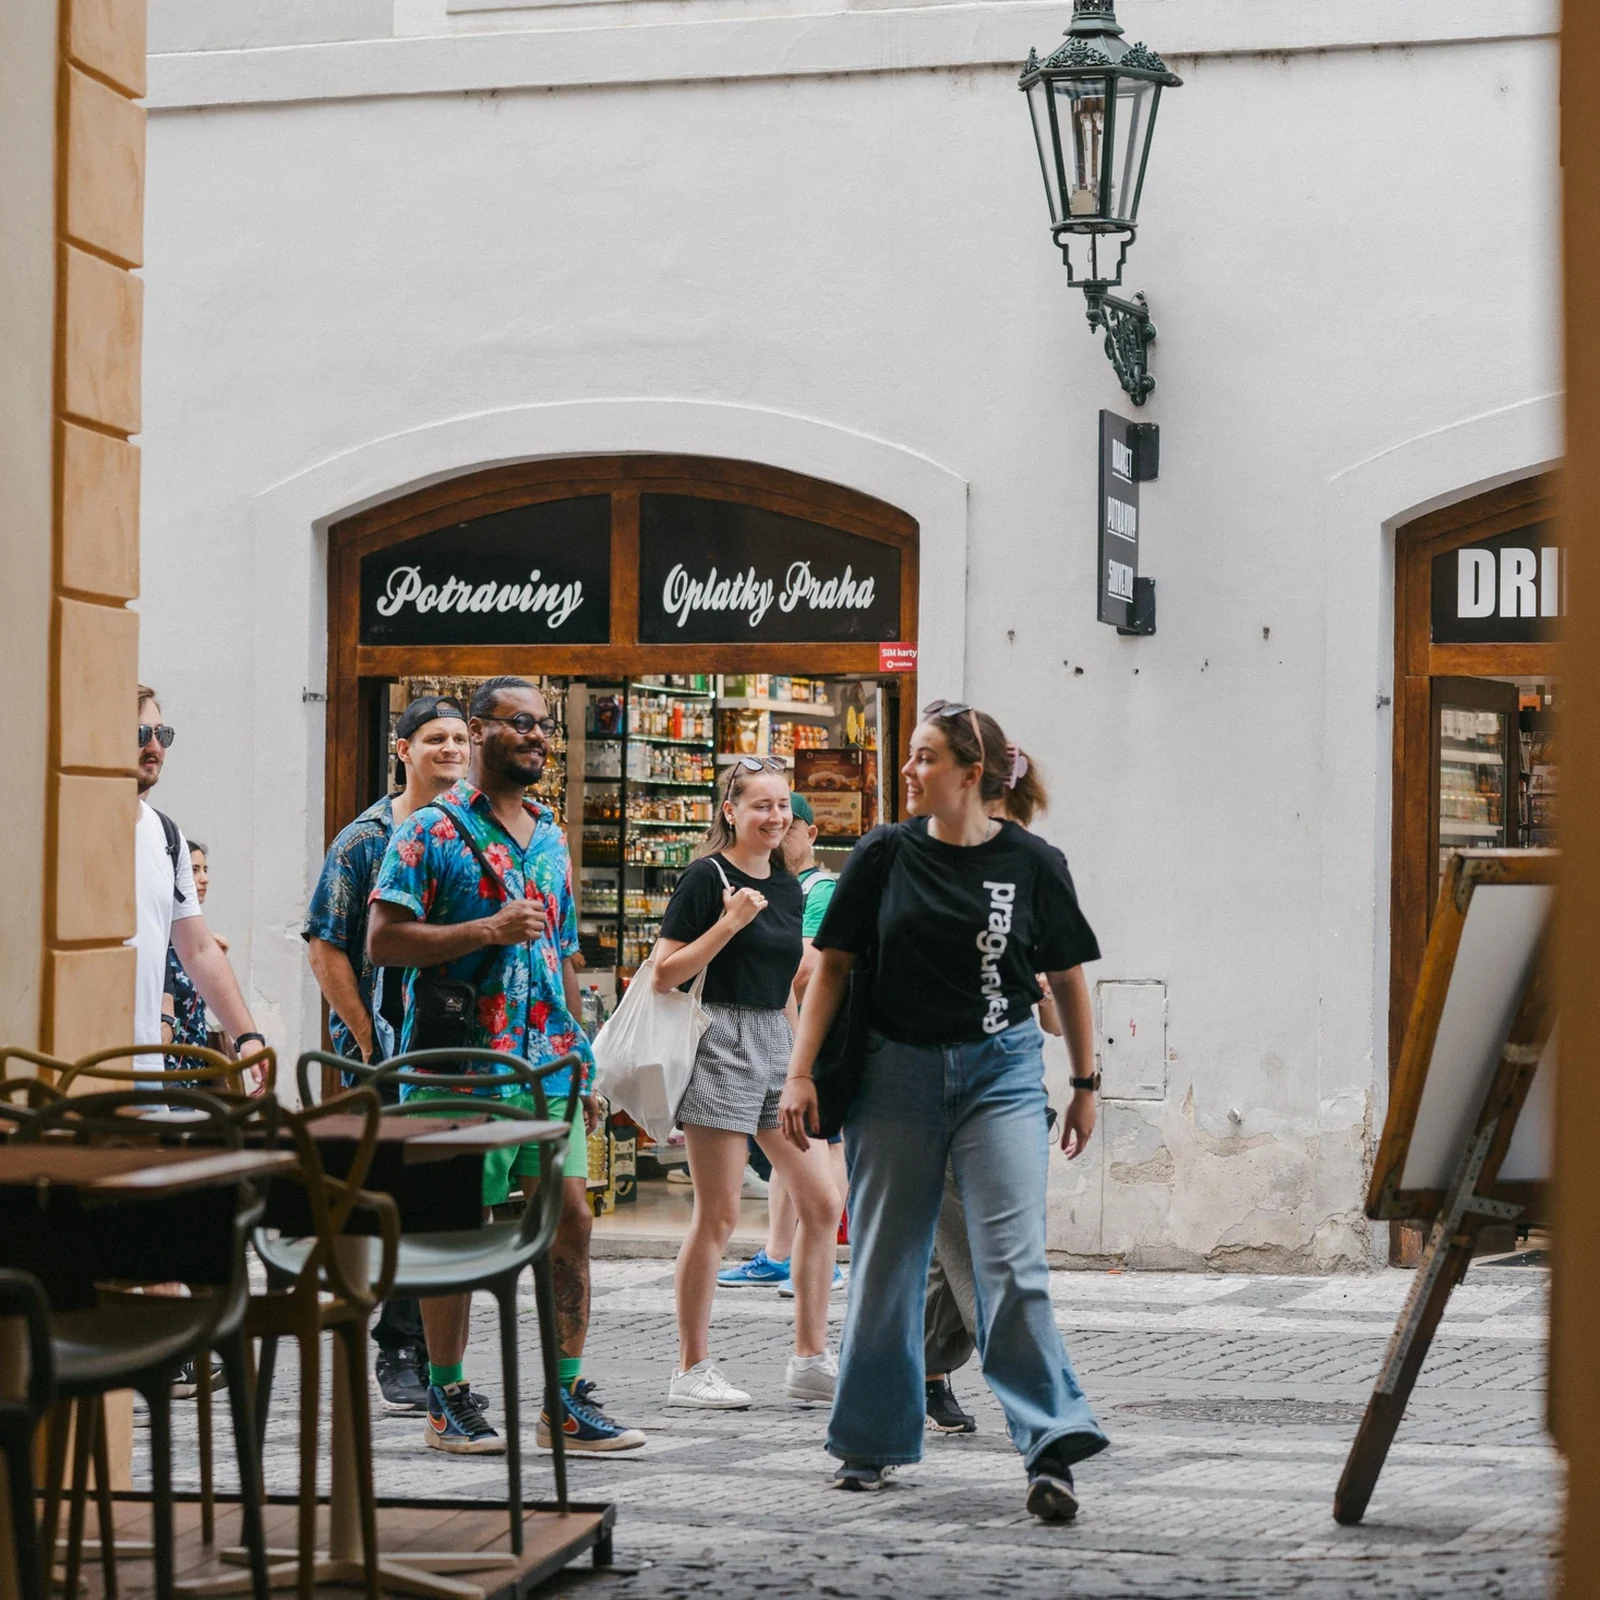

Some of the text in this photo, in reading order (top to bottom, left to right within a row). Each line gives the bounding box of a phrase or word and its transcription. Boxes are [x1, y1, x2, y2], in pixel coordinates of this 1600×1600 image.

[376, 565, 584, 629] Potraviny
[662, 560, 875, 627] Oplatky Praha
[1457, 547, 1567, 618] DRI
[881, 648, 917, 658] SIM karty
